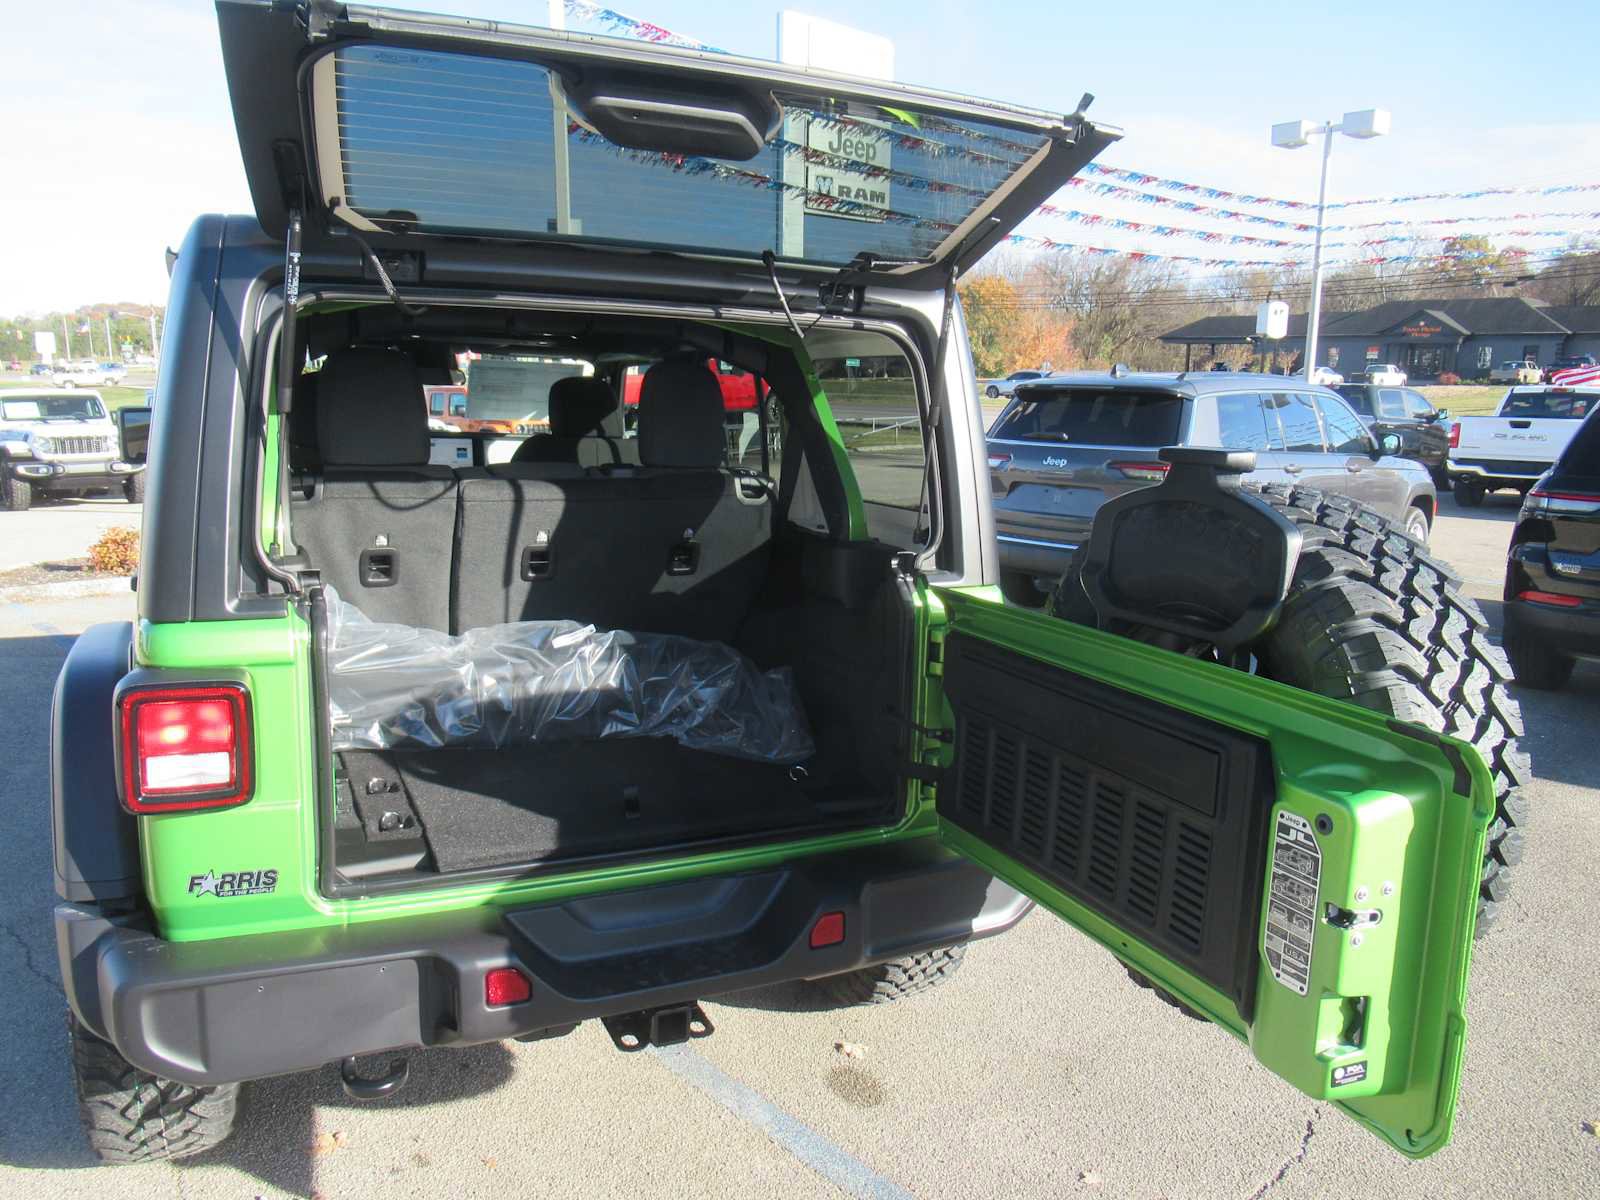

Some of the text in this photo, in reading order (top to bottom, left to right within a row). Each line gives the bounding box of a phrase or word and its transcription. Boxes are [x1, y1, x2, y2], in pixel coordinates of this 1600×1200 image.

[828, 125, 877, 163] Jeep
[837, 184, 886, 204] RAM
[1042, 456, 1068, 468] Jeep
